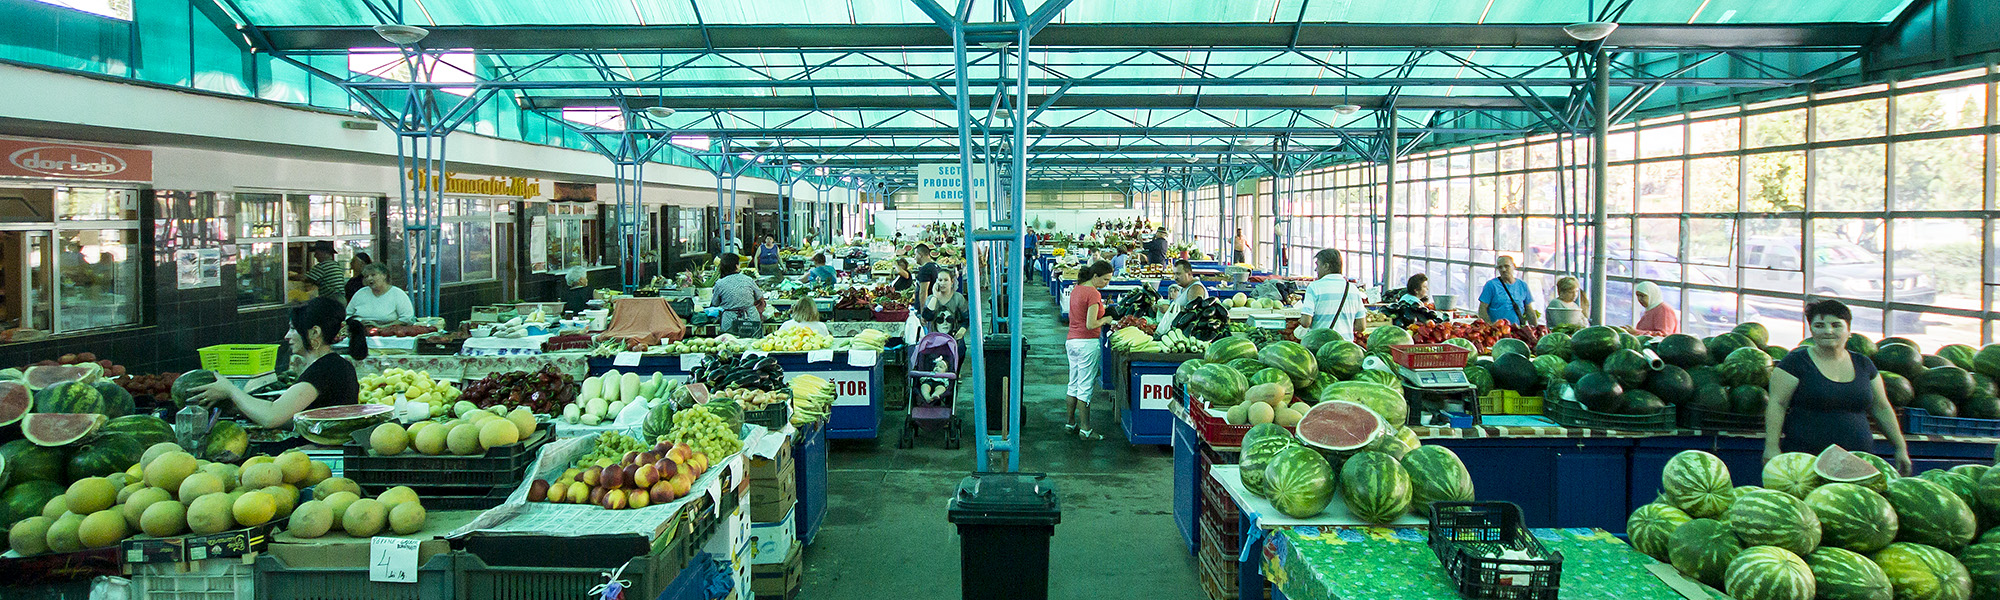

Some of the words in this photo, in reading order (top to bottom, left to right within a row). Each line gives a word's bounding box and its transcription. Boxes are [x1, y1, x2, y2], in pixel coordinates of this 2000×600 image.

[938, 166, 961, 175] SECT
[923, 178, 985, 187] PRODUCOR
[934, 190, 978, 199] AGRICI
[125, 194, 131, 205] 7
[377, 549, 391, 577] 4
